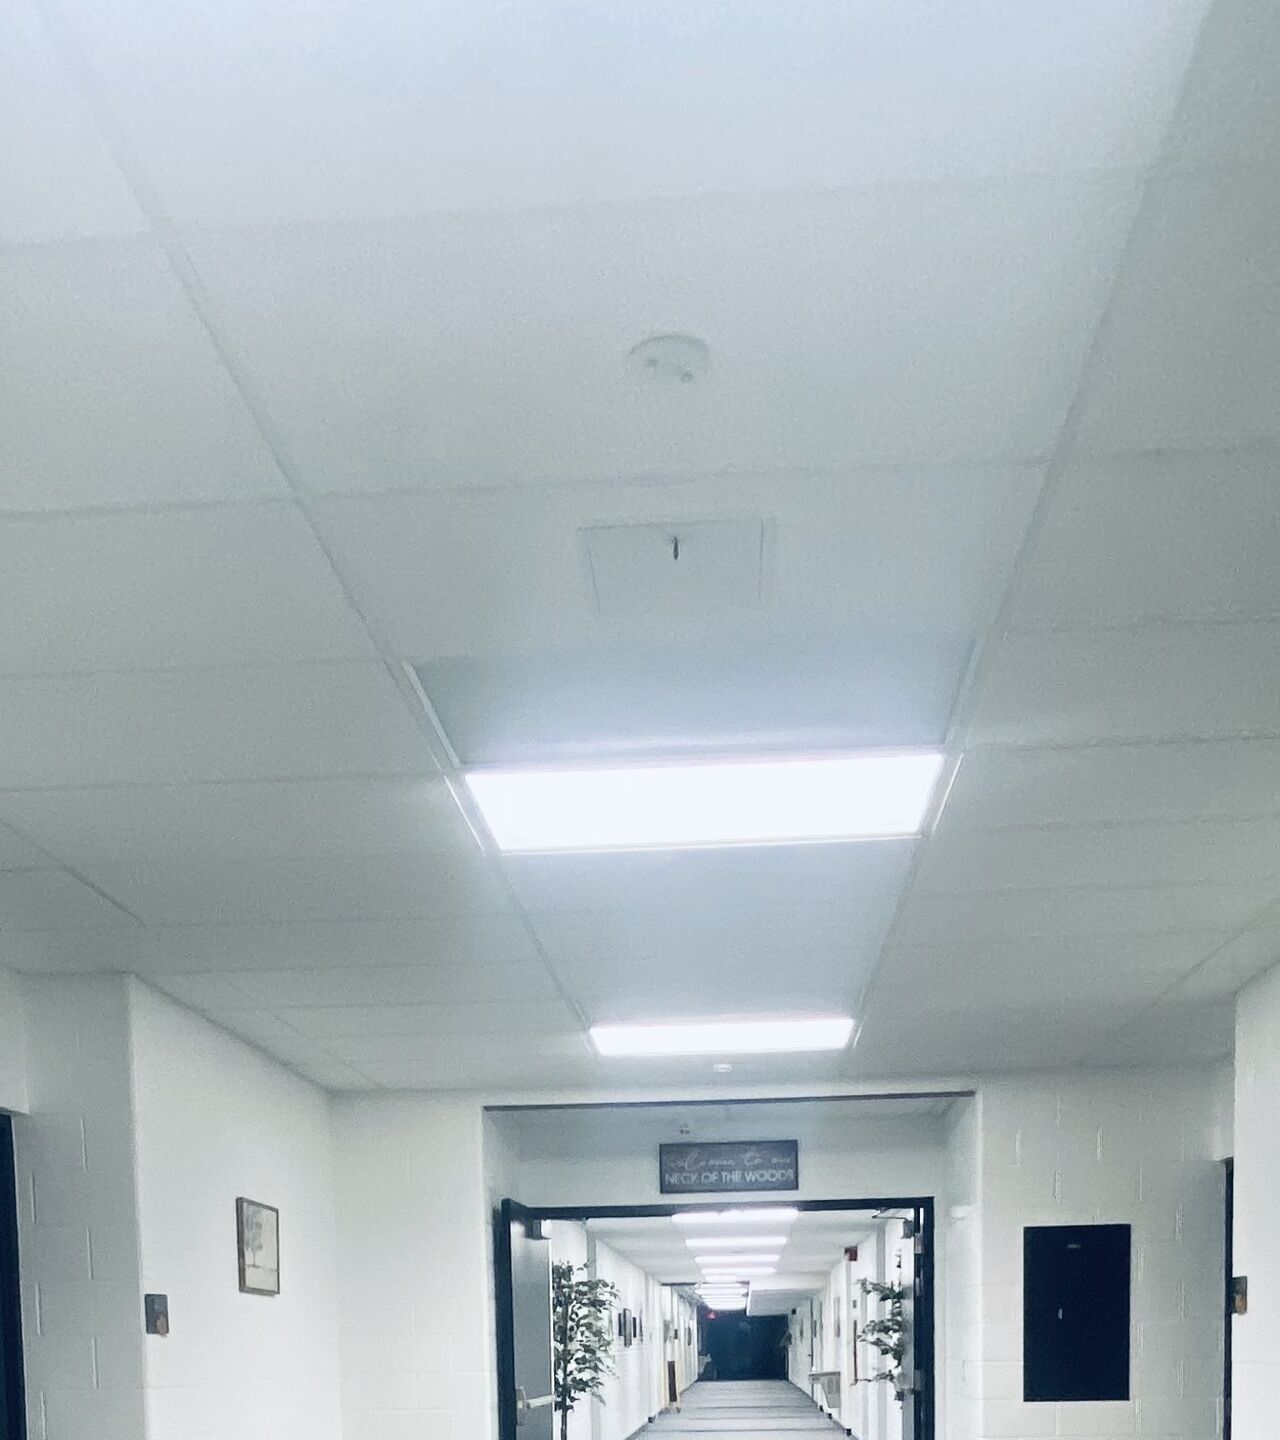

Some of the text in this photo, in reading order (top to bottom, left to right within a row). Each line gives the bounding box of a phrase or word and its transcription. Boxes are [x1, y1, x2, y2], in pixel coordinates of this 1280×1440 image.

[664, 1168, 794, 1185] NECK OF THE WOODS
